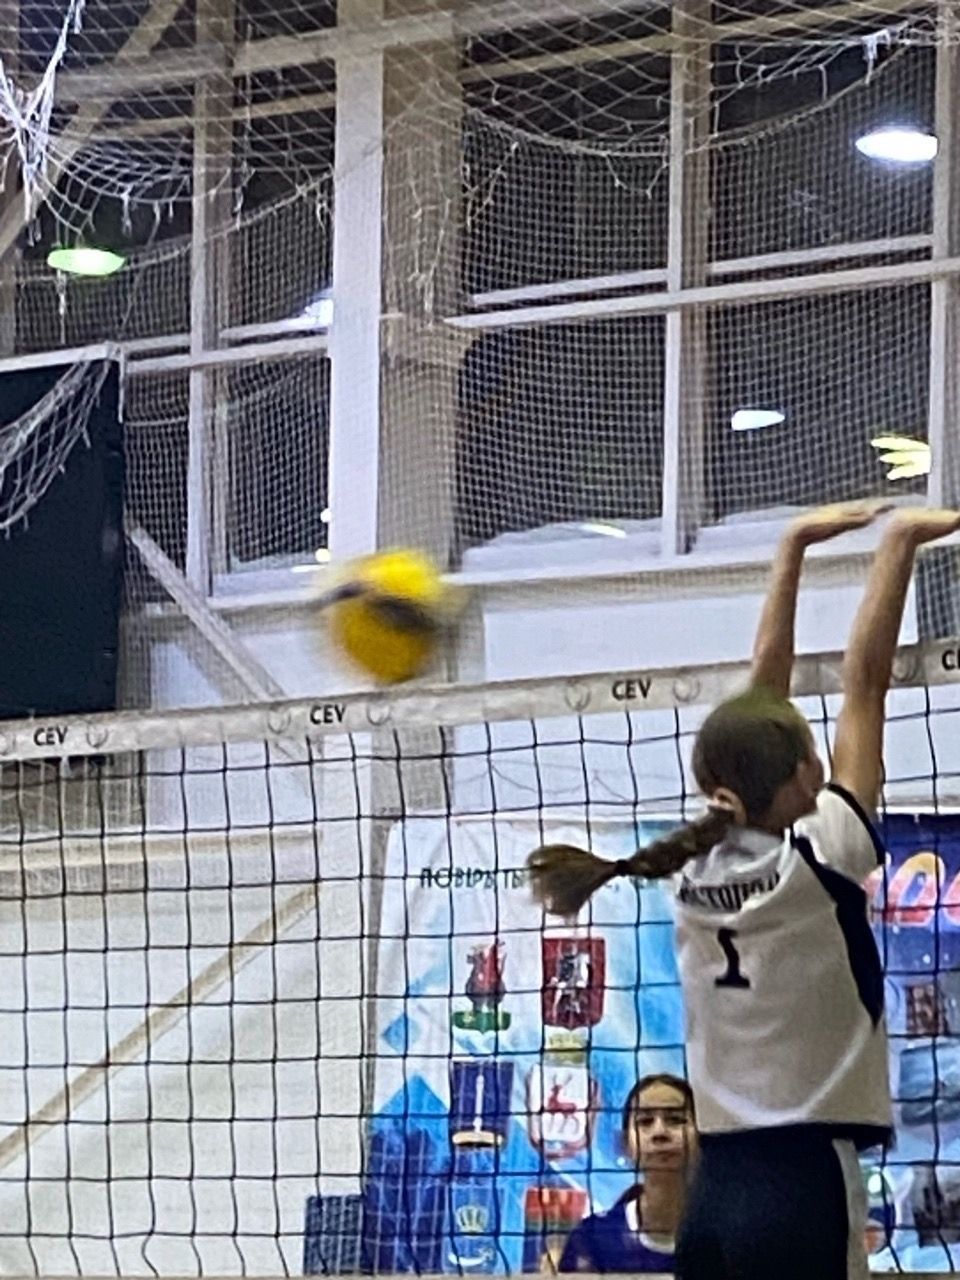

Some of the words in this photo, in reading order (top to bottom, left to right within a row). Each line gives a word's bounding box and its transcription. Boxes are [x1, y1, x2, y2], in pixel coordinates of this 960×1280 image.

[611, 678, 653, 701] CEV
[309, 703, 347, 725] CEV
[33, 724, 69, 748] CEV
[714, 927, 751, 989] 1
